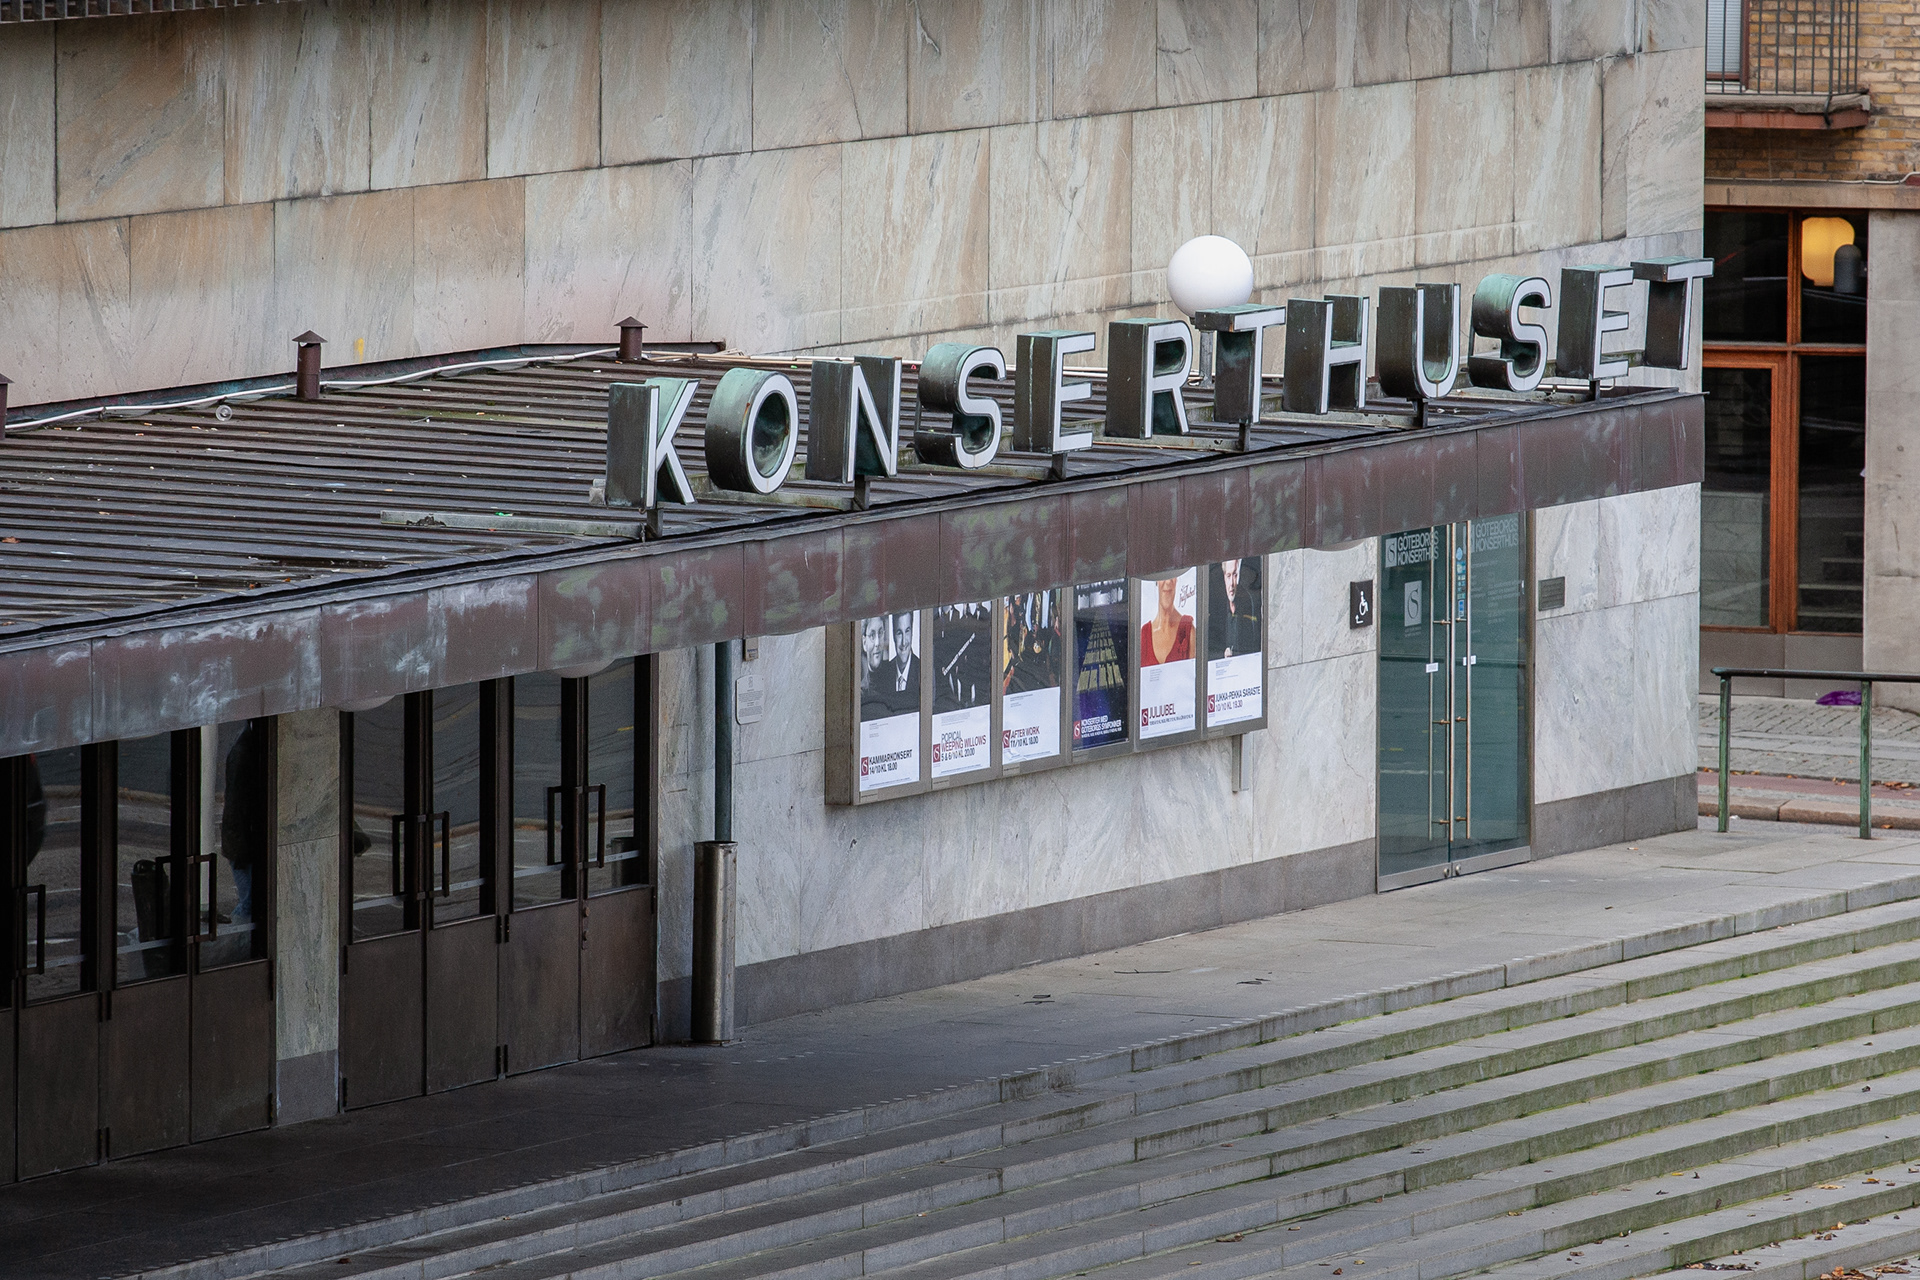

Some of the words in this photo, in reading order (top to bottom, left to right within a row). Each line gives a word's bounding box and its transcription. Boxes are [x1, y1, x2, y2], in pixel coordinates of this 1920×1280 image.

[606, 257, 1714, 509] KONSERTHUSET
[1475, 532, 1518, 553] KONSERTHUS
[1215, 689, 1242, 703] JUKKA-PEKKA
[1242, 685, 1261, 698] SARASTE
[1149, 703, 1176, 719] JULJUBEL
[1227, 701, 1232, 710] KL
[1010, 728, 1025, 739] AFTER
[1025, 726, 1040, 737] WORK
[941, 737, 963, 753] WEEPING
[964, 734, 987, 748] WILLOWS
[1022, 737, 1028, 746] KL
[869, 748, 913, 765] KAMMARKONSERT
[958, 749, 964, 758] KL
